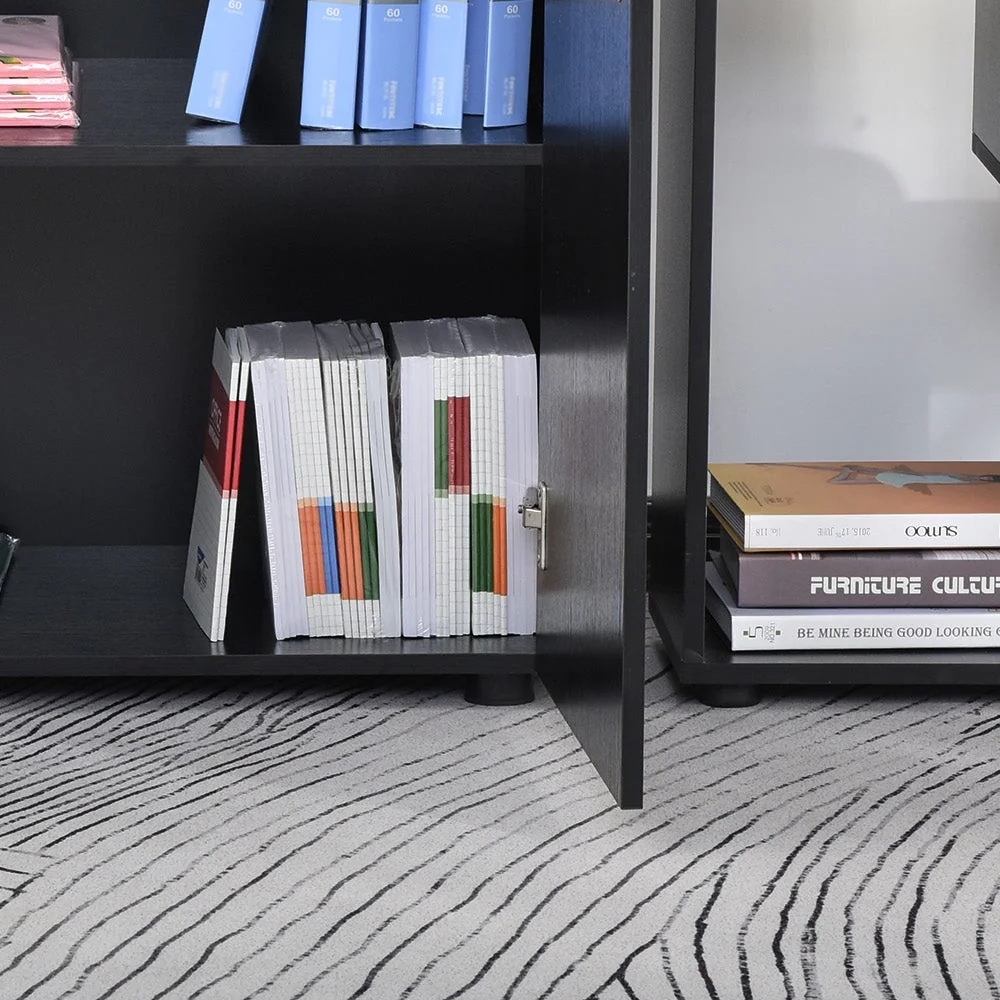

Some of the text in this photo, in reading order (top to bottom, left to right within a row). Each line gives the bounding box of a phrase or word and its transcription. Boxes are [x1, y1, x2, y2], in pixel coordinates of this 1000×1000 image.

[228, 0, 242, 10] 60
[434, 4, 449, 14] 60
[506, 5, 519, 14] 60
[326, 7, 340, 17] 60
[386, 8, 400, 18] 60
[810, 576, 1000, 594] FURNITURE CULTU
[797, 627, 814, 639] BE
[818, 627, 850, 639] MINE
[854, 627, 893, 638] BEING
[896, 627, 932, 638] GOOD
[936, 627, 992, 638] LOOKING
